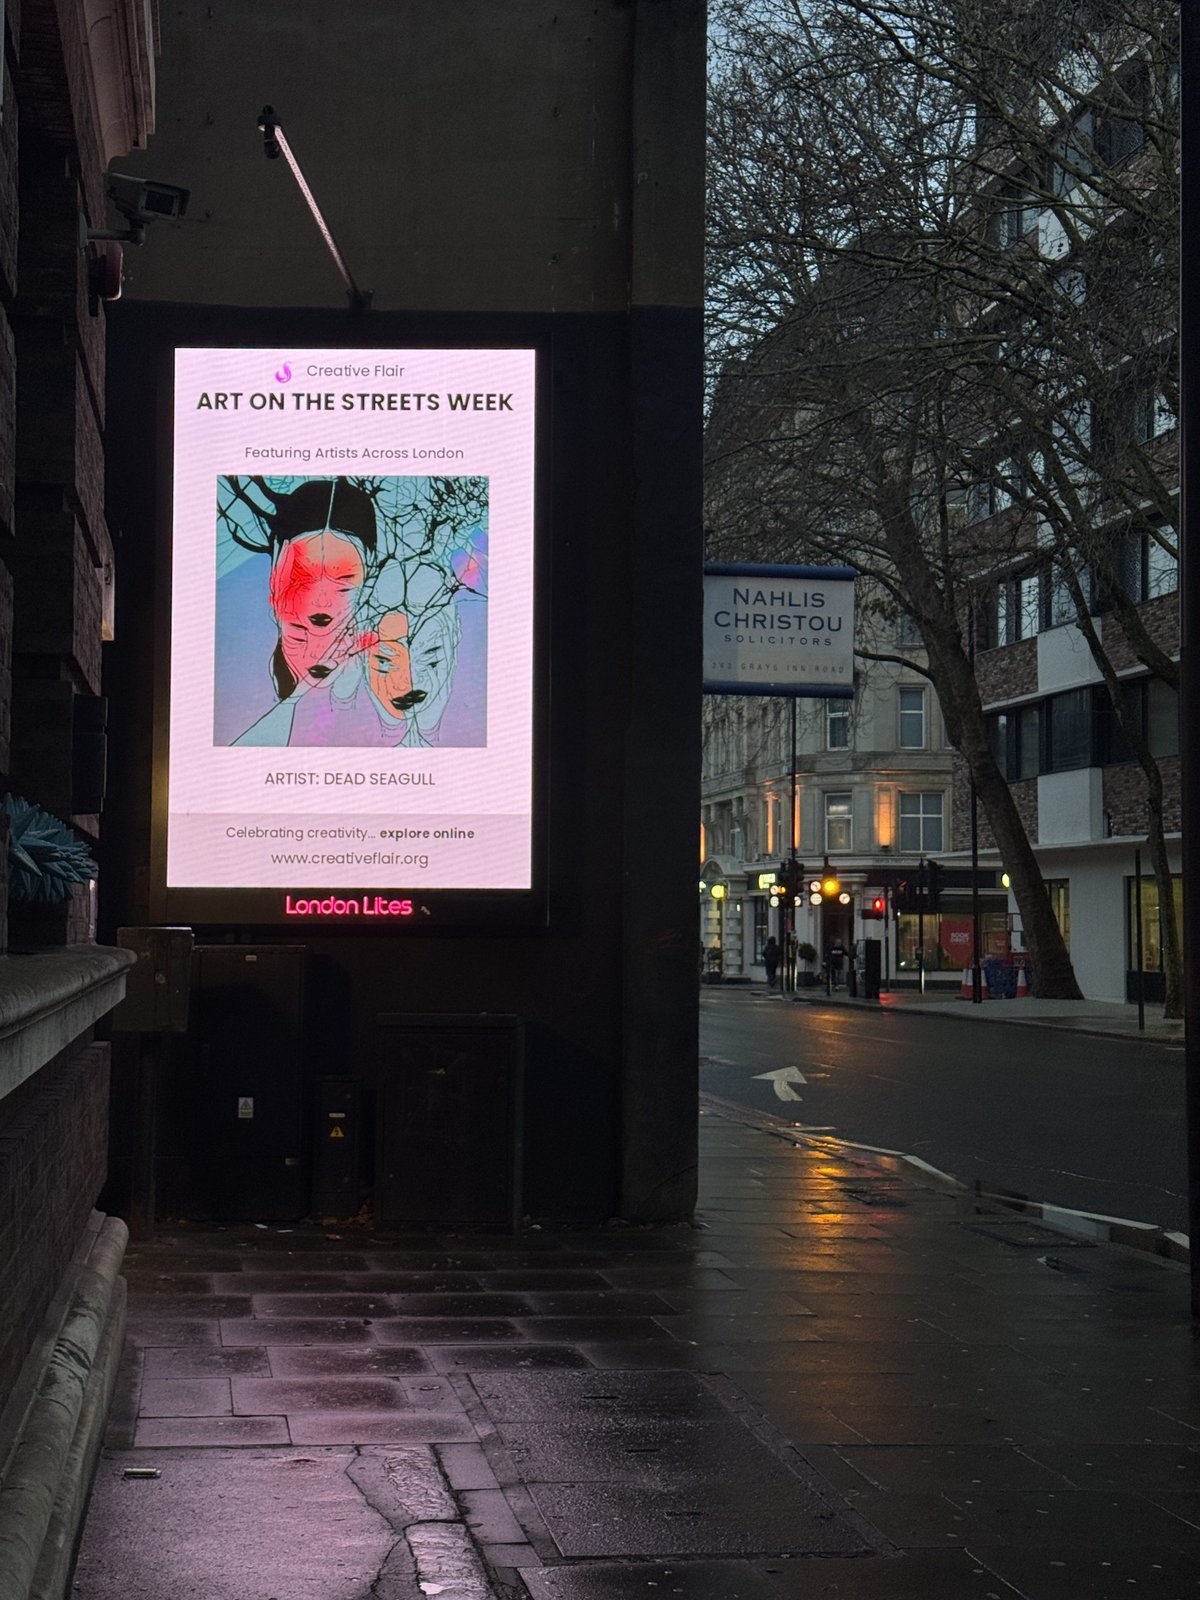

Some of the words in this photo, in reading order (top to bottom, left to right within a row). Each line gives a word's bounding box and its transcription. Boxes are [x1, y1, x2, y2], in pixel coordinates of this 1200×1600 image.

[306, 364, 370, 377] Creative
[374, 364, 405, 377] Flair
[196, 392, 244, 410] ART
[249, 392, 285, 411] ON
[291, 392, 335, 411] THE
[341, 392, 440, 411] STREETS
[447, 393, 514, 411] WEEK
[245, 446, 311, 462] Featuring
[315, 446, 358, 459] Artists
[361, 447, 409, 459] Across
[412, 447, 464, 459] London
[733, 588, 826, 608] NAHLIS
[714, 611, 842, 632] CHRISTOU
[724, 634, 832, 646] SOLICITORS
[264, 772, 320, 785] ARTIST:
[324, 772, 366, 785] DEAD
[369, 772, 436, 786] SEAGULL
[226, 826, 304, 842] Celebrating
[307, 827, 376, 842] creativity...
[379, 827, 430, 842] explore
[433, 826, 475, 839] online
[270, 851, 429, 869] www.creativeflair.org
[285, 895, 359, 915] London
[362, 895, 413, 915] Lites
